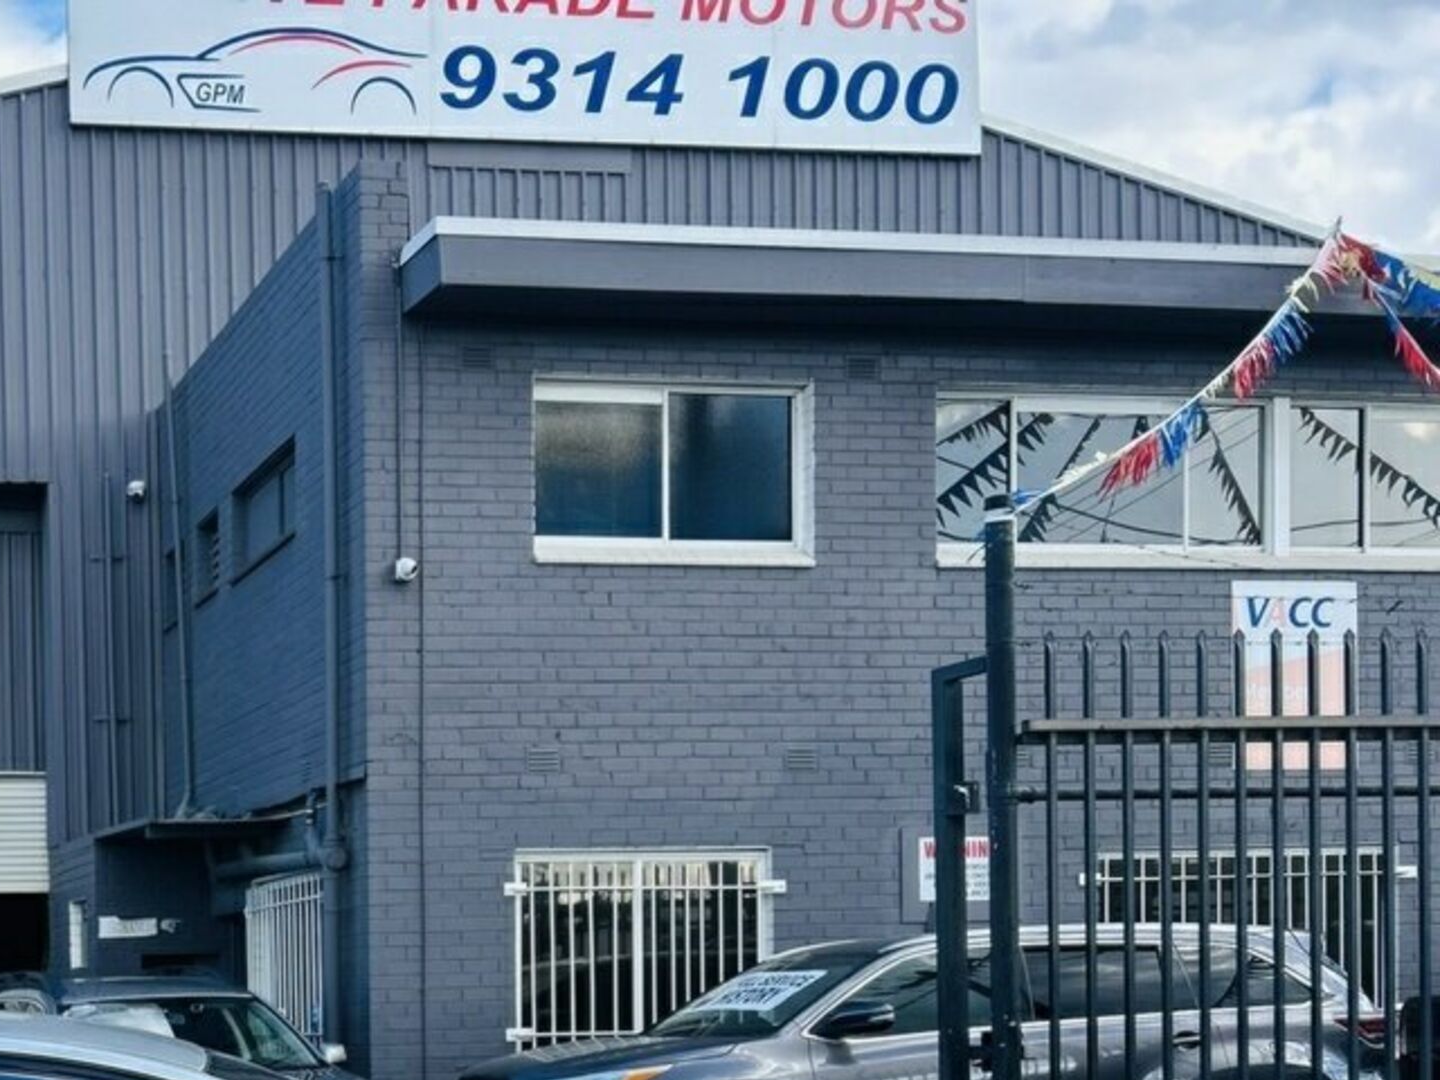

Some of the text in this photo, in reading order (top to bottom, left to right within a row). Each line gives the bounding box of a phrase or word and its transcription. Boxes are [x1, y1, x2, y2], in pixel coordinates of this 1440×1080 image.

[195, 82, 245, 104] GPM
[440, 45, 960, 125] 9314 1000
[1246, 597, 1336, 628] VACC
